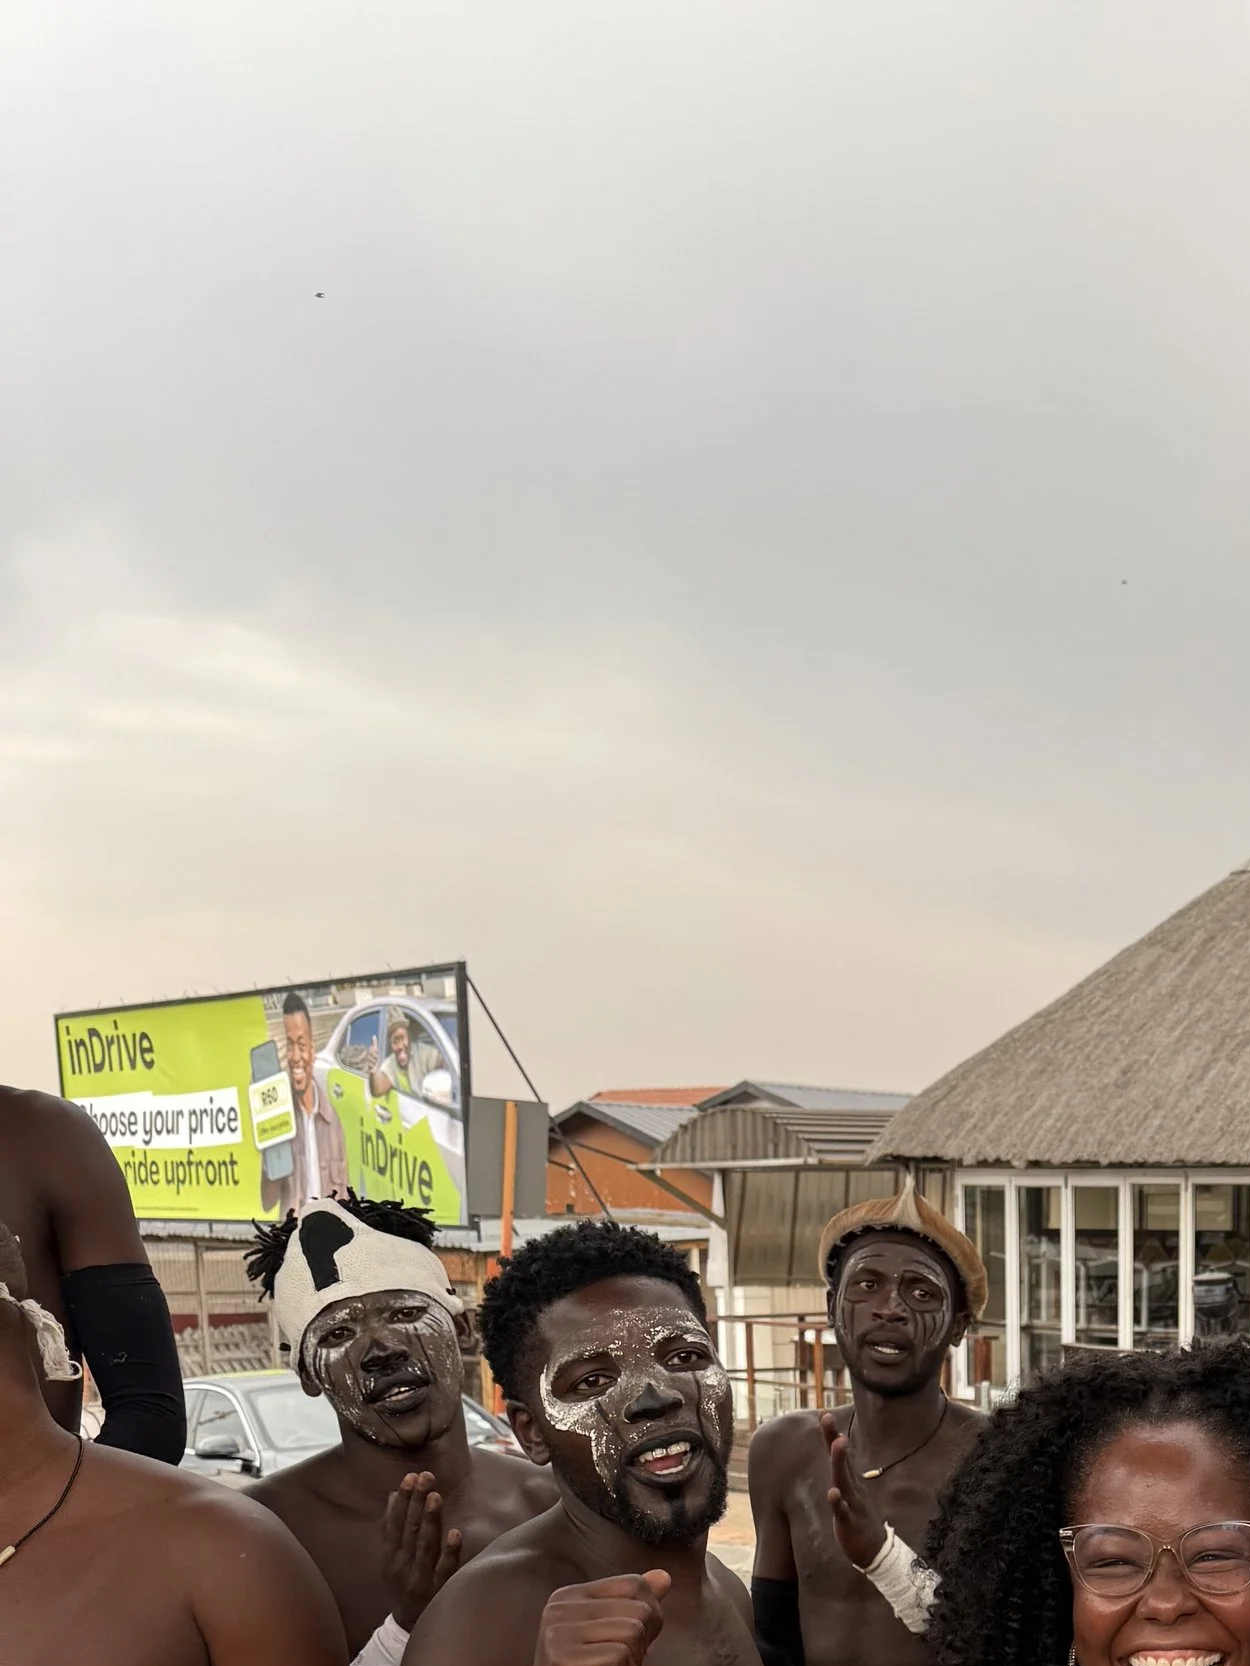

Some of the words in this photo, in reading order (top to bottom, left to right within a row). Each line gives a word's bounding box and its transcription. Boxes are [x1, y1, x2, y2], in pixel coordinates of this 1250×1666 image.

[65, 1019, 155, 1076] inDrive
[80, 1103, 138, 1138] hoose
[142, 1108, 184, 1146] your
[188, 1096, 239, 1145] price
[124, 1150, 160, 1186] ride
[164, 1148, 240, 1195] upfront
[360, 1117, 433, 1206] inDrive
